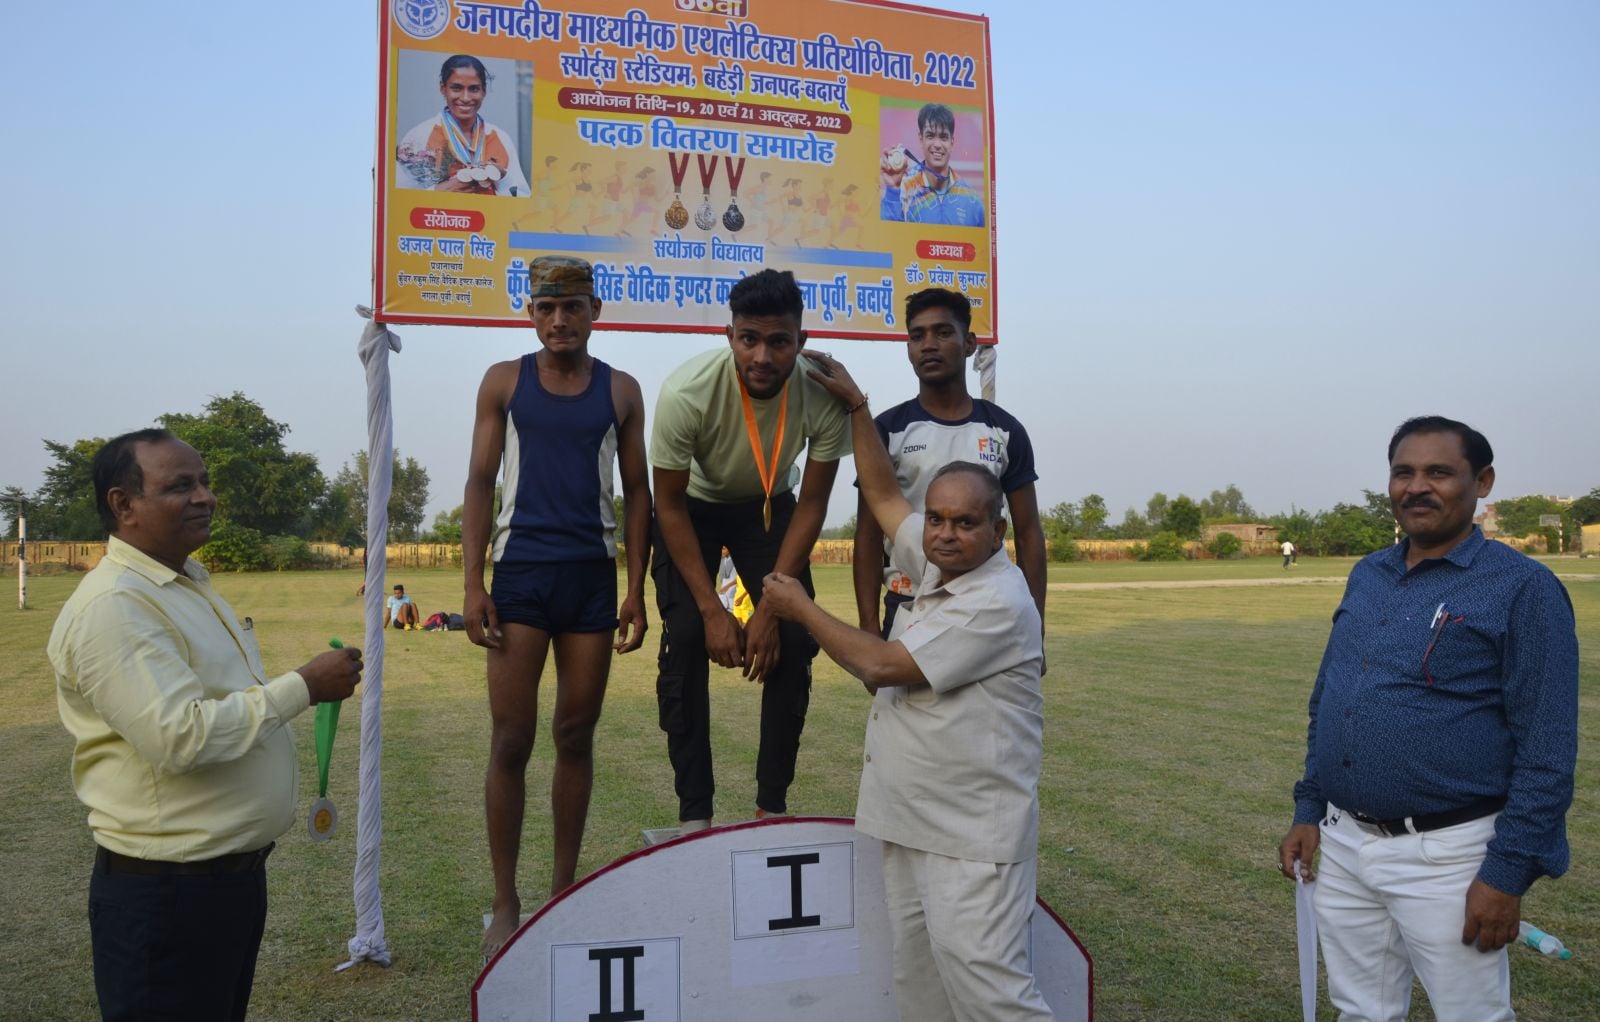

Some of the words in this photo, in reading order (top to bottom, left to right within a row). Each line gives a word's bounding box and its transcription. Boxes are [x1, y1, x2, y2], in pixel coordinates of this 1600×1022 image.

[456, 0, 561, 40] जनपदीय
[567, 10, 676, 50] माध्यमिक
[682, 21, 796, 65] एथलेटिक्स
[802, 33, 920, 84] प्रतियोगिता,
[925, 51, 975, 88] 2022
[560, 49, 616, 87] स्पोर्ट्स
[623, 53, 696, 87] स्टेडियम,
[704, 61, 744, 95] बहेड़ी
[570, 91, 631, 108] आयोजन
[700, 103, 713, 115] 20
[718, 103, 739, 117] एवं
[741, 108, 753, 119] 21
[759, 109, 811, 128] अक्टूबर,
[815, 116, 841, 128] 2022
[579, 120, 643, 146] पदक
[651, 118, 739, 153] वितरण
[746, 131, 834, 163] समारोह
[424, 210, 471, 229] संयोजक
[399, 237, 433, 255] अजय
[438, 238, 464, 256] पाल
[470, 235, 495, 259] सिंह
[655, 234, 706, 259] संयोजक
[711, 237, 764, 262] विद्यालय
[929, 244, 963, 257] अध्यक्ष
[594, 264, 624, 301] सिंह
[625, 265, 670, 303] वैदिक
[675, 275, 713, 308] इण्टर
[856, 279, 894, 324] बदायूँ
[928, 266, 953, 284] प्रवेश
[958, 271, 987, 290] कुमार
[767, 852, 820, 930] I
[588, 945, 644, 1021] II
